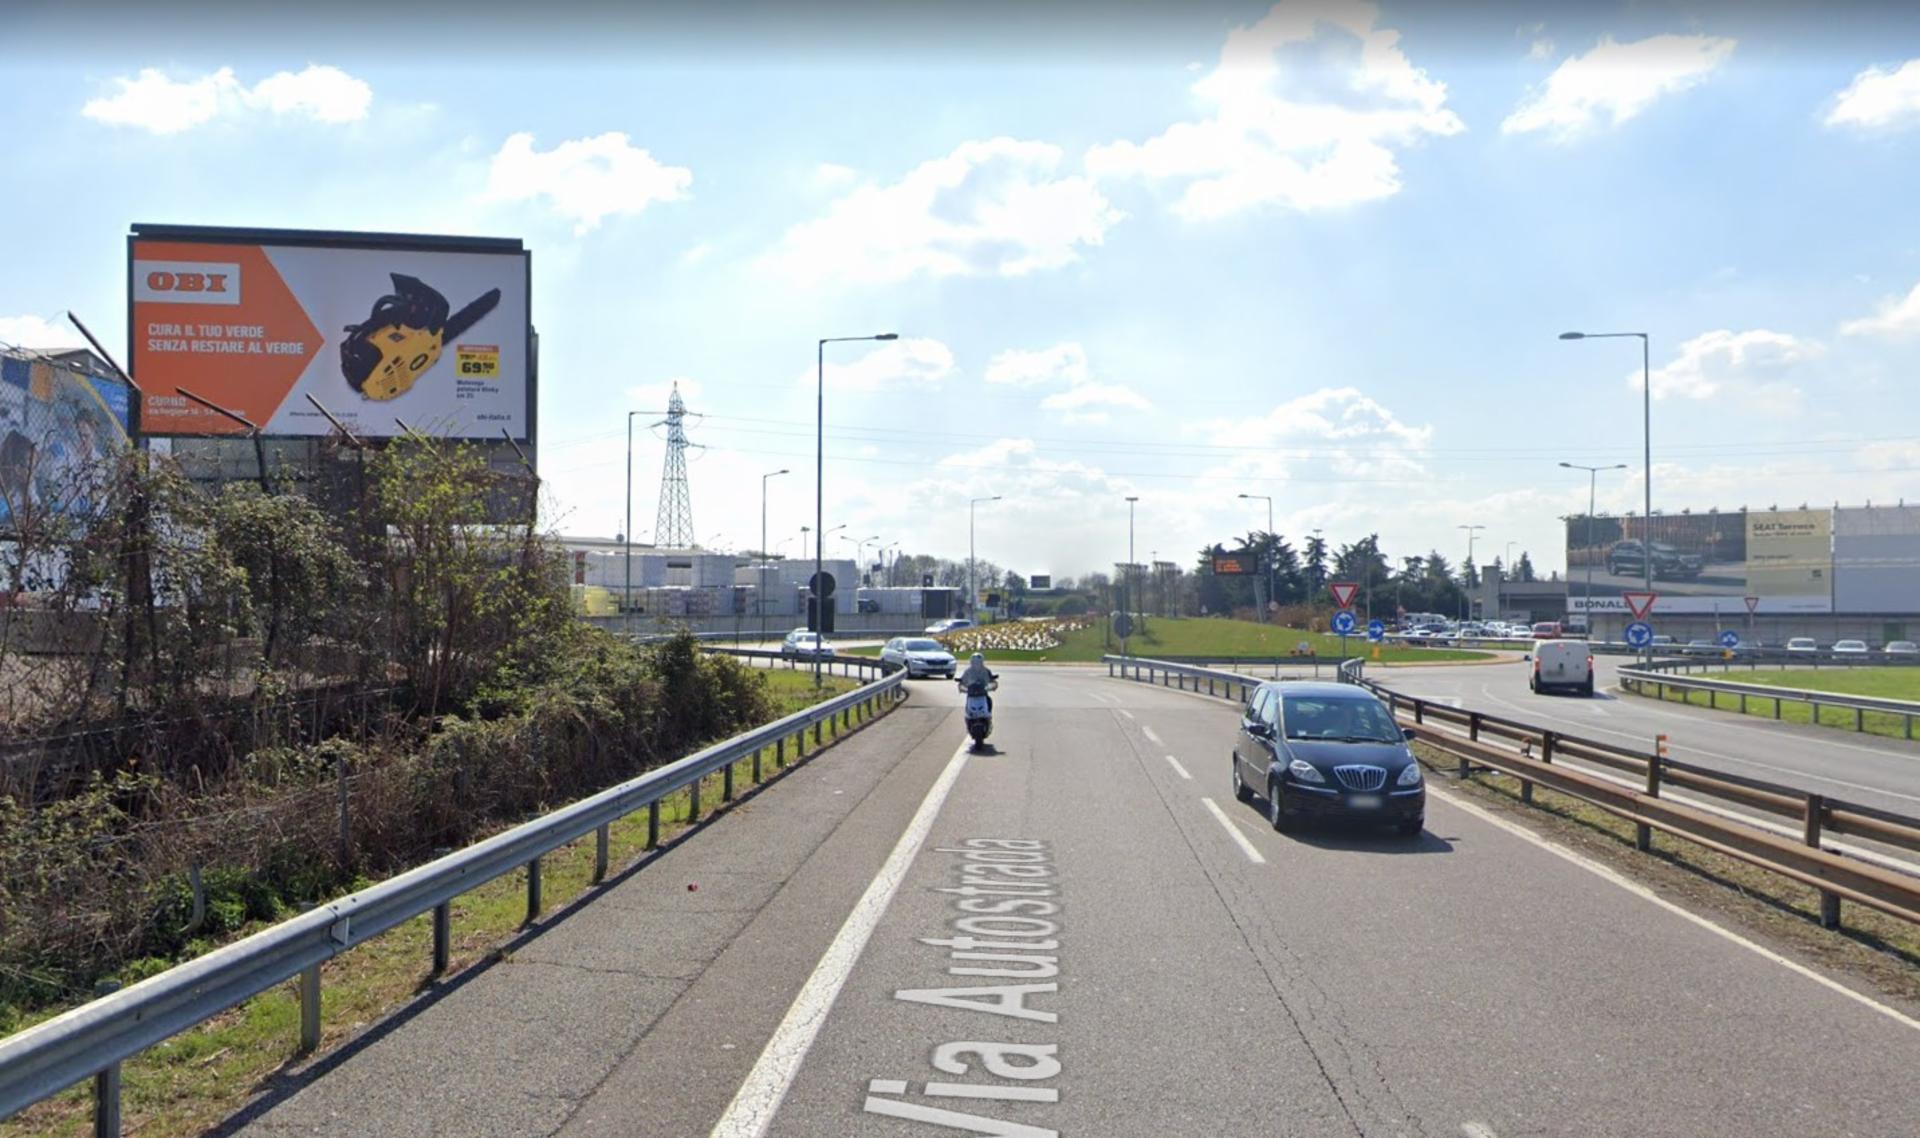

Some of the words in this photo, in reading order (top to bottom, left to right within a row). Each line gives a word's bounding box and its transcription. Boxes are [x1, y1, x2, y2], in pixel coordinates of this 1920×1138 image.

[147, 271, 228, 293] OBI
[148, 323, 182, 337] CURA
[185, 324, 196, 337] IL
[199, 325, 222, 338] TUO
[225, 325, 264, 339] VERDE
[148, 339, 188, 352] SENZA
[191, 340, 245, 354] RESTARE
[247, 341, 263, 354] AL
[265, 342, 305, 355] VERDE
[1753, 523, 1776, 531] SEAT
